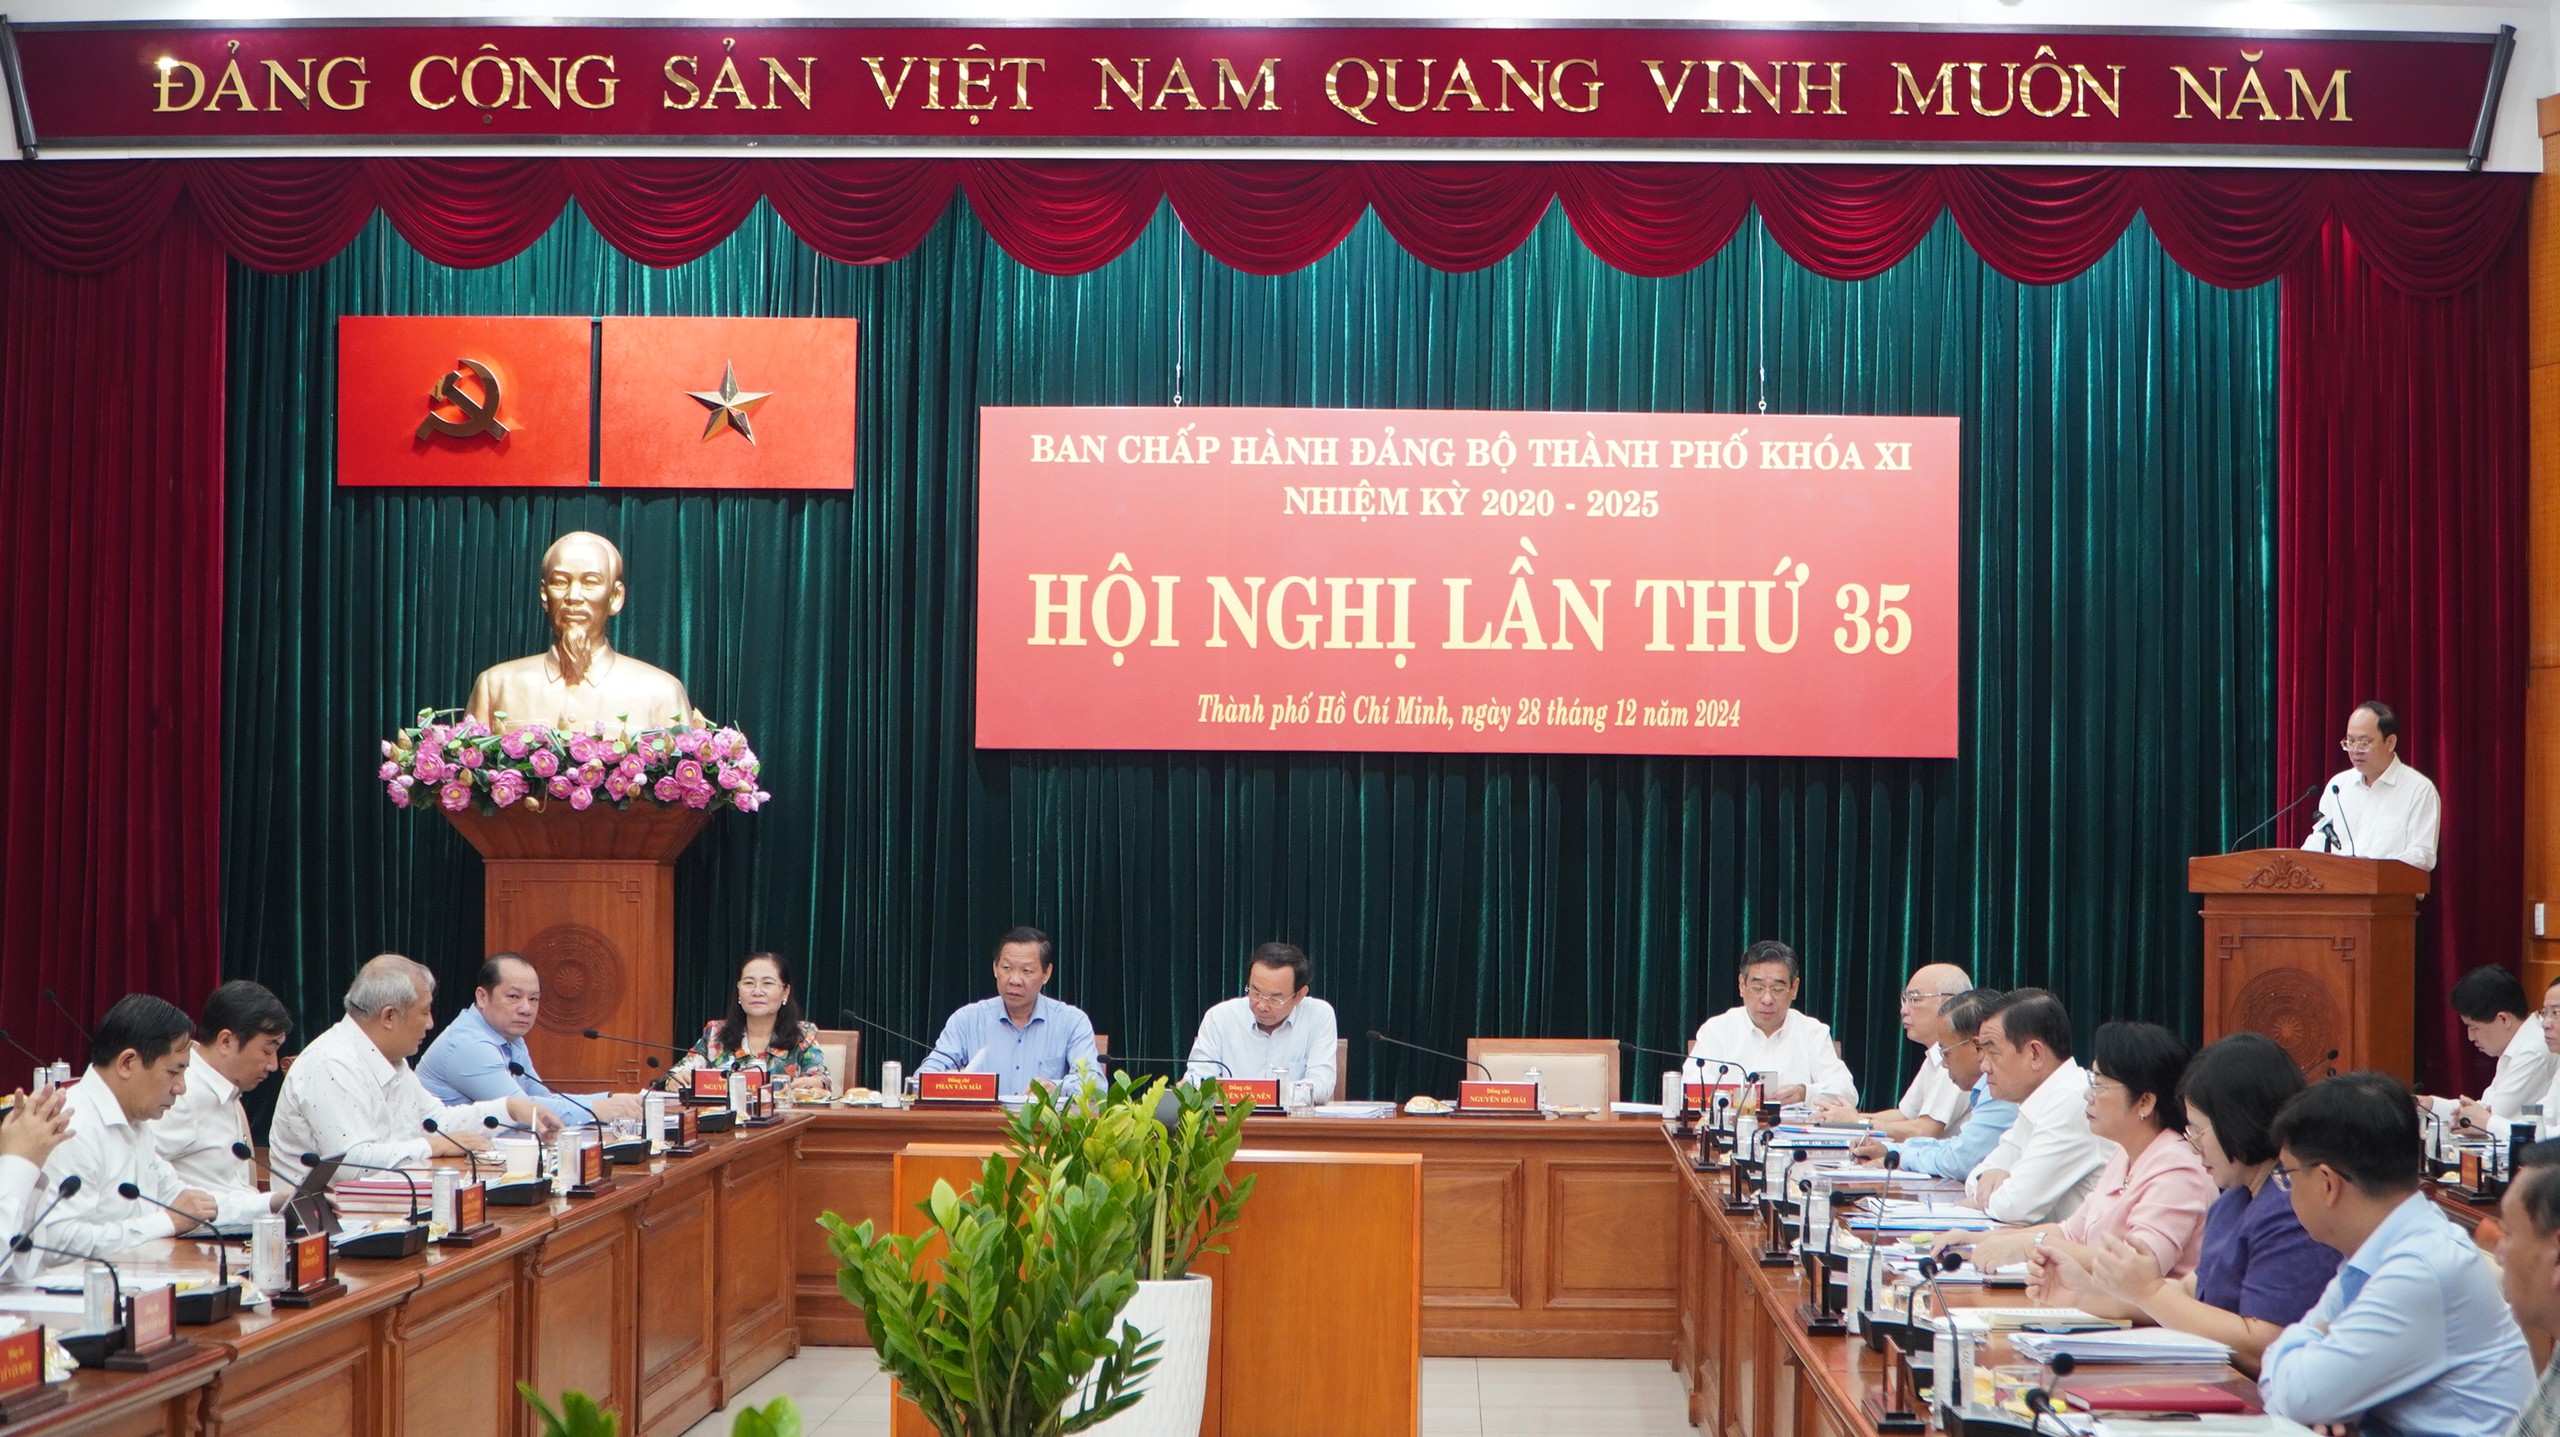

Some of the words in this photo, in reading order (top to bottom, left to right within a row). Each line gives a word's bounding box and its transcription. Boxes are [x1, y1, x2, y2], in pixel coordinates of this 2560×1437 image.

[150, 40, 371, 112] ĐẢNG
[410, 43, 620, 125] CỘNG
[664, 38, 817, 110] SẢN
[861, 44, 1045, 125] VIỆT
[1092, 57, 1282, 111] NAM
[1325, 58, 1604, 125] QUANG
[1641, 60, 1847, 114] VINH
[1890, 45, 2126, 118] MUÔN
[2170, 49, 2353, 121] NĂM
[1030, 434, 1107, 464] BAN
[1117, 423, 1220, 465] CHẤP
[1231, 428, 1339, 466] HÀNH
[1350, 426, 1456, 467] ĐẢNG
[1466, 430, 1517, 474] BỘ
[1528, 431, 1659, 469] THÀNH
[1670, 428, 1749, 469] PHỐ
[1759, 433, 1865, 471] KHÓA
[1874, 442, 1913, 471] XI
[1283, 479, 1410, 522] NHIỆM
[1419, 479, 1470, 516] KỲ
[1481, 487, 1555, 517] 2020
[1586, 485, 1660, 518] 2025
[1028, 552, 1180, 666] HỘI
[1206, 576, 1416, 668] NGHỊ
[1442, 536, 1611, 651] LẦN
[1635, 556, 1809, 653] THỨ
[1834, 583, 1911, 654] 35
[1199, 694, 1264, 723] Thành
[1269, 692, 1312, 730] phố
[1316, 691, 1346, 724] Hồ
[1354, 696, 1390, 724] Chí
[1395, 696, 1453, 730] Minh,
[1462, 697, 1511, 731] ngày
[1517, 698, 1540, 725] 28
[1547, 697, 1608, 732] tháng
[1615, 699, 1636, 725] 12
[1644, 700, 1688, 726] năm
[1695, 700, 1740, 727] 2024
